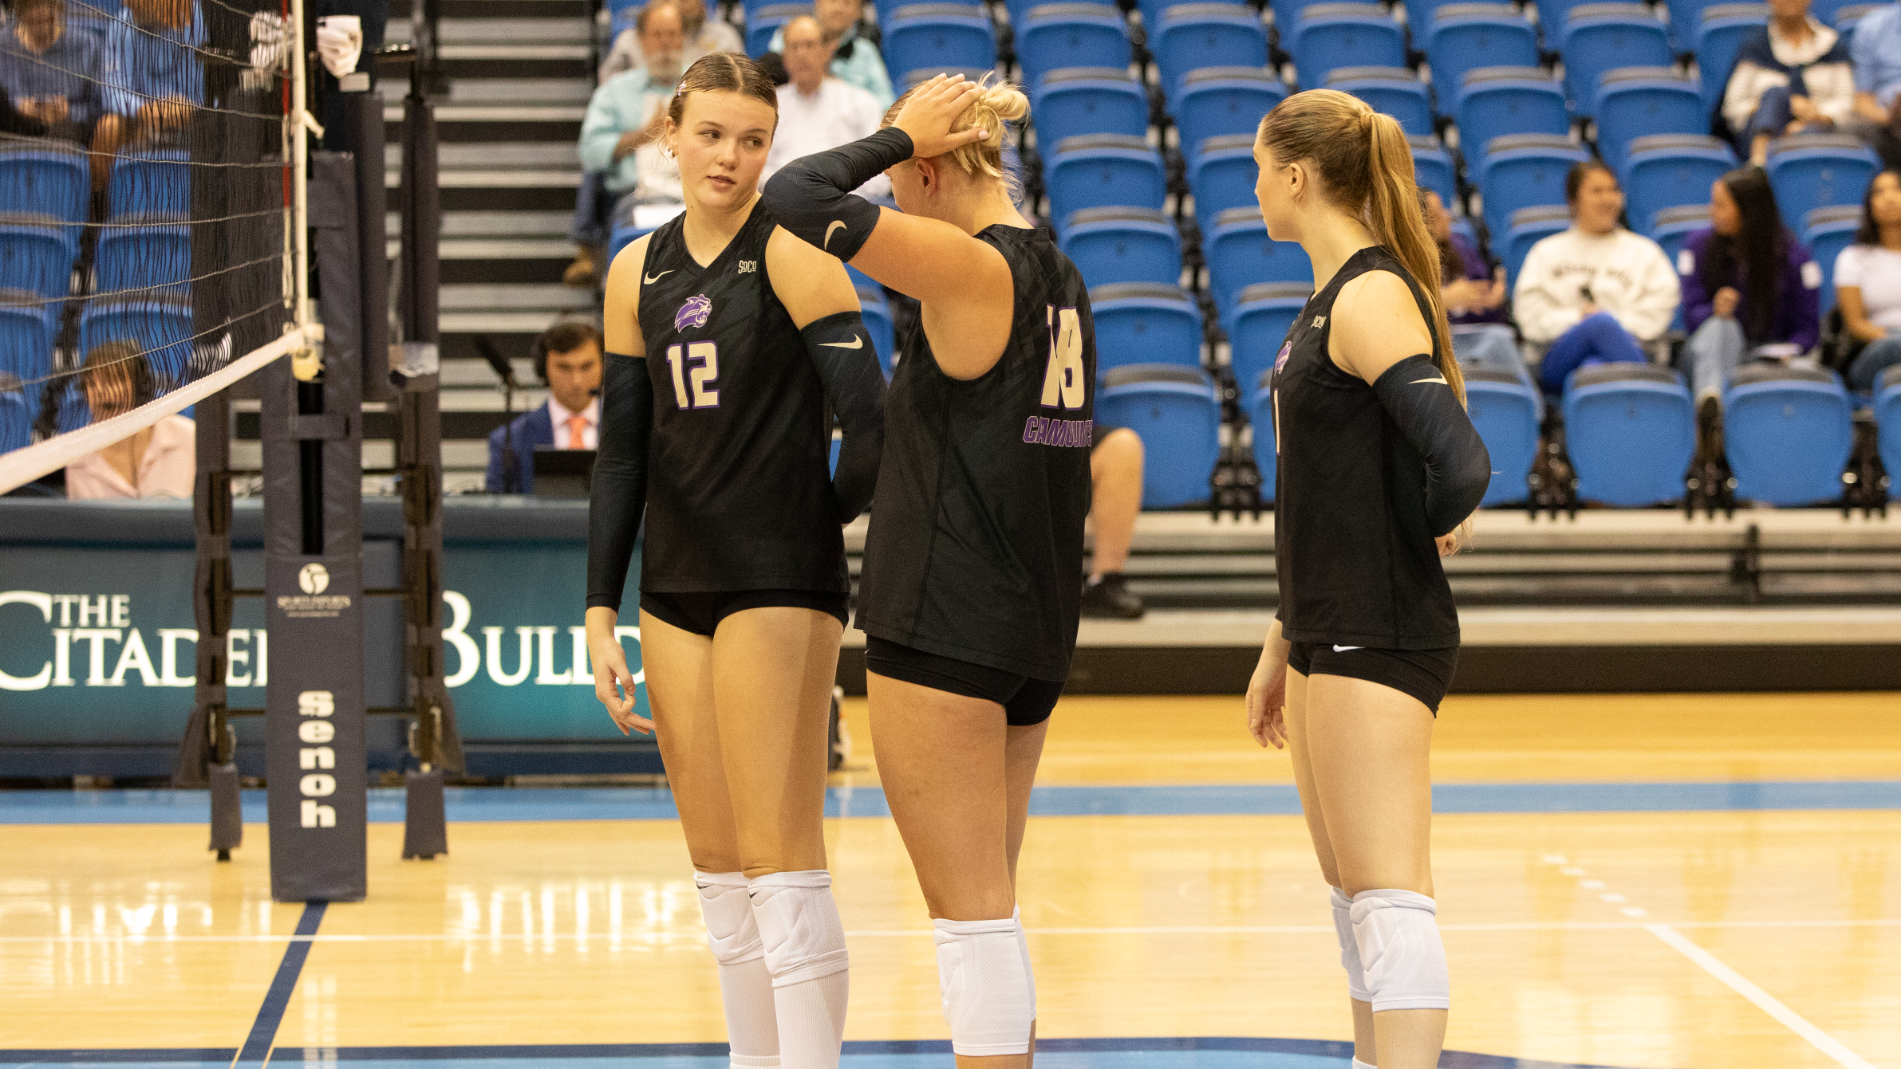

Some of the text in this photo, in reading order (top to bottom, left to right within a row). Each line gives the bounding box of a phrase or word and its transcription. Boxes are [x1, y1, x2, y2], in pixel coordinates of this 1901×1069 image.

[666, 340, 720, 410] 12
[1041, 303, 1085, 411] 18
[52, 594, 131, 628] THE
[298, 690, 336, 828] senoh
